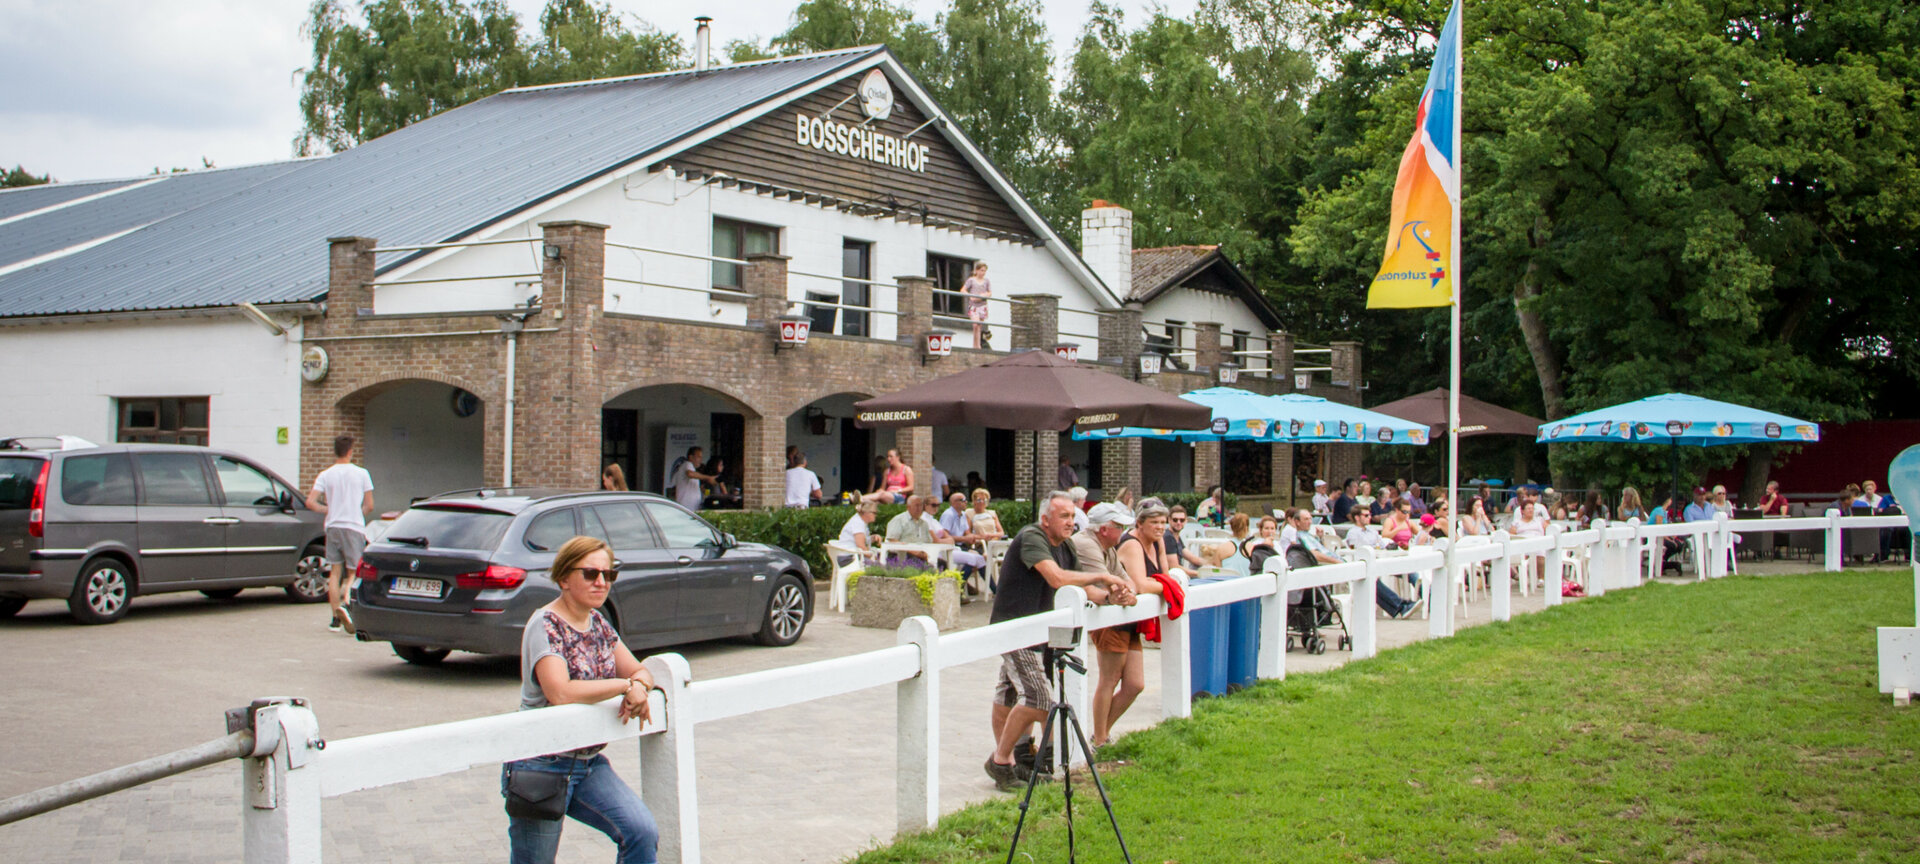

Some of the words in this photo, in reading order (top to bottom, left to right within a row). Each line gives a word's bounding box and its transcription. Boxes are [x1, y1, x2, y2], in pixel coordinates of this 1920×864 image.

[796, 113, 929, 173] BOSSCHERHOF
[860, 411, 918, 422] GRIMBERGEN
[1078, 413, 1116, 424] GRIMBERGEN
